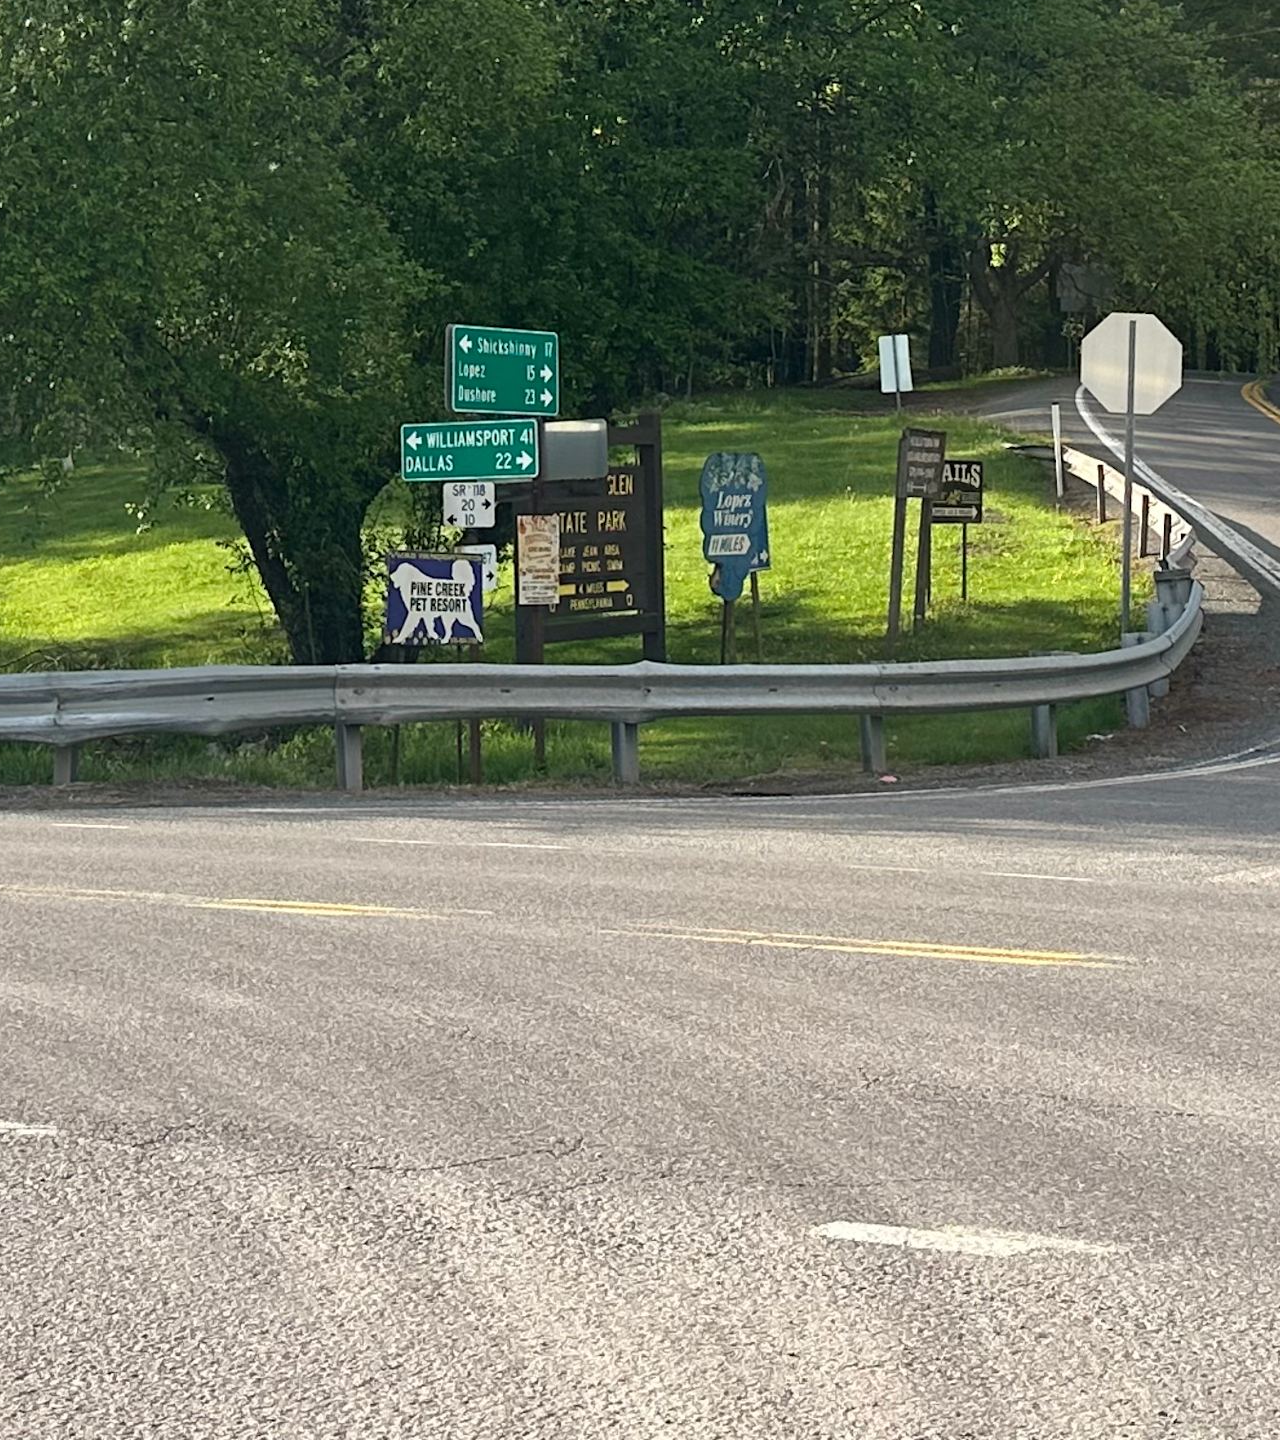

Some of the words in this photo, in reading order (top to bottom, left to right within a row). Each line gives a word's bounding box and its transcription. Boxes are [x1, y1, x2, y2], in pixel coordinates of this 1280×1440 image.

[477, 337, 536, 359] Shickshinny
[545, 342, 553, 358] 17
[459, 360, 486, 379] Lopez
[527, 365, 536, 381] 15
[458, 385, 496, 403] Dushore
[525, 389, 536, 404] 23
[426, 428, 515, 448] WILLIAMSPORT
[520, 428, 533, 445] 41
[406, 455, 453, 472] DALLAS
[495, 453, 512, 469] 22
[942, 464, 981, 489] AILS
[452, 484, 466, 496] SR
[474, 484, 486, 496] 118
[461, 499, 475, 511] 20
[717, 491, 752, 511] Lopez
[465, 514, 475, 526] 10
[558, 511, 588, 533] TATE
[598, 510, 626, 532] PARK
[714, 509, 753, 528] Winery
[711, 536, 719, 553] 11
[720, 535, 746, 552] MILES
[411, 582, 433, 596] PINE
[436, 583, 465, 597] CREEK
[585, 582, 605, 594] MILES
[410, 597, 426, 611] PET
[430, 598, 467, 612] RESORT
[570, 597, 613, 611] PENNSYLVANIA
